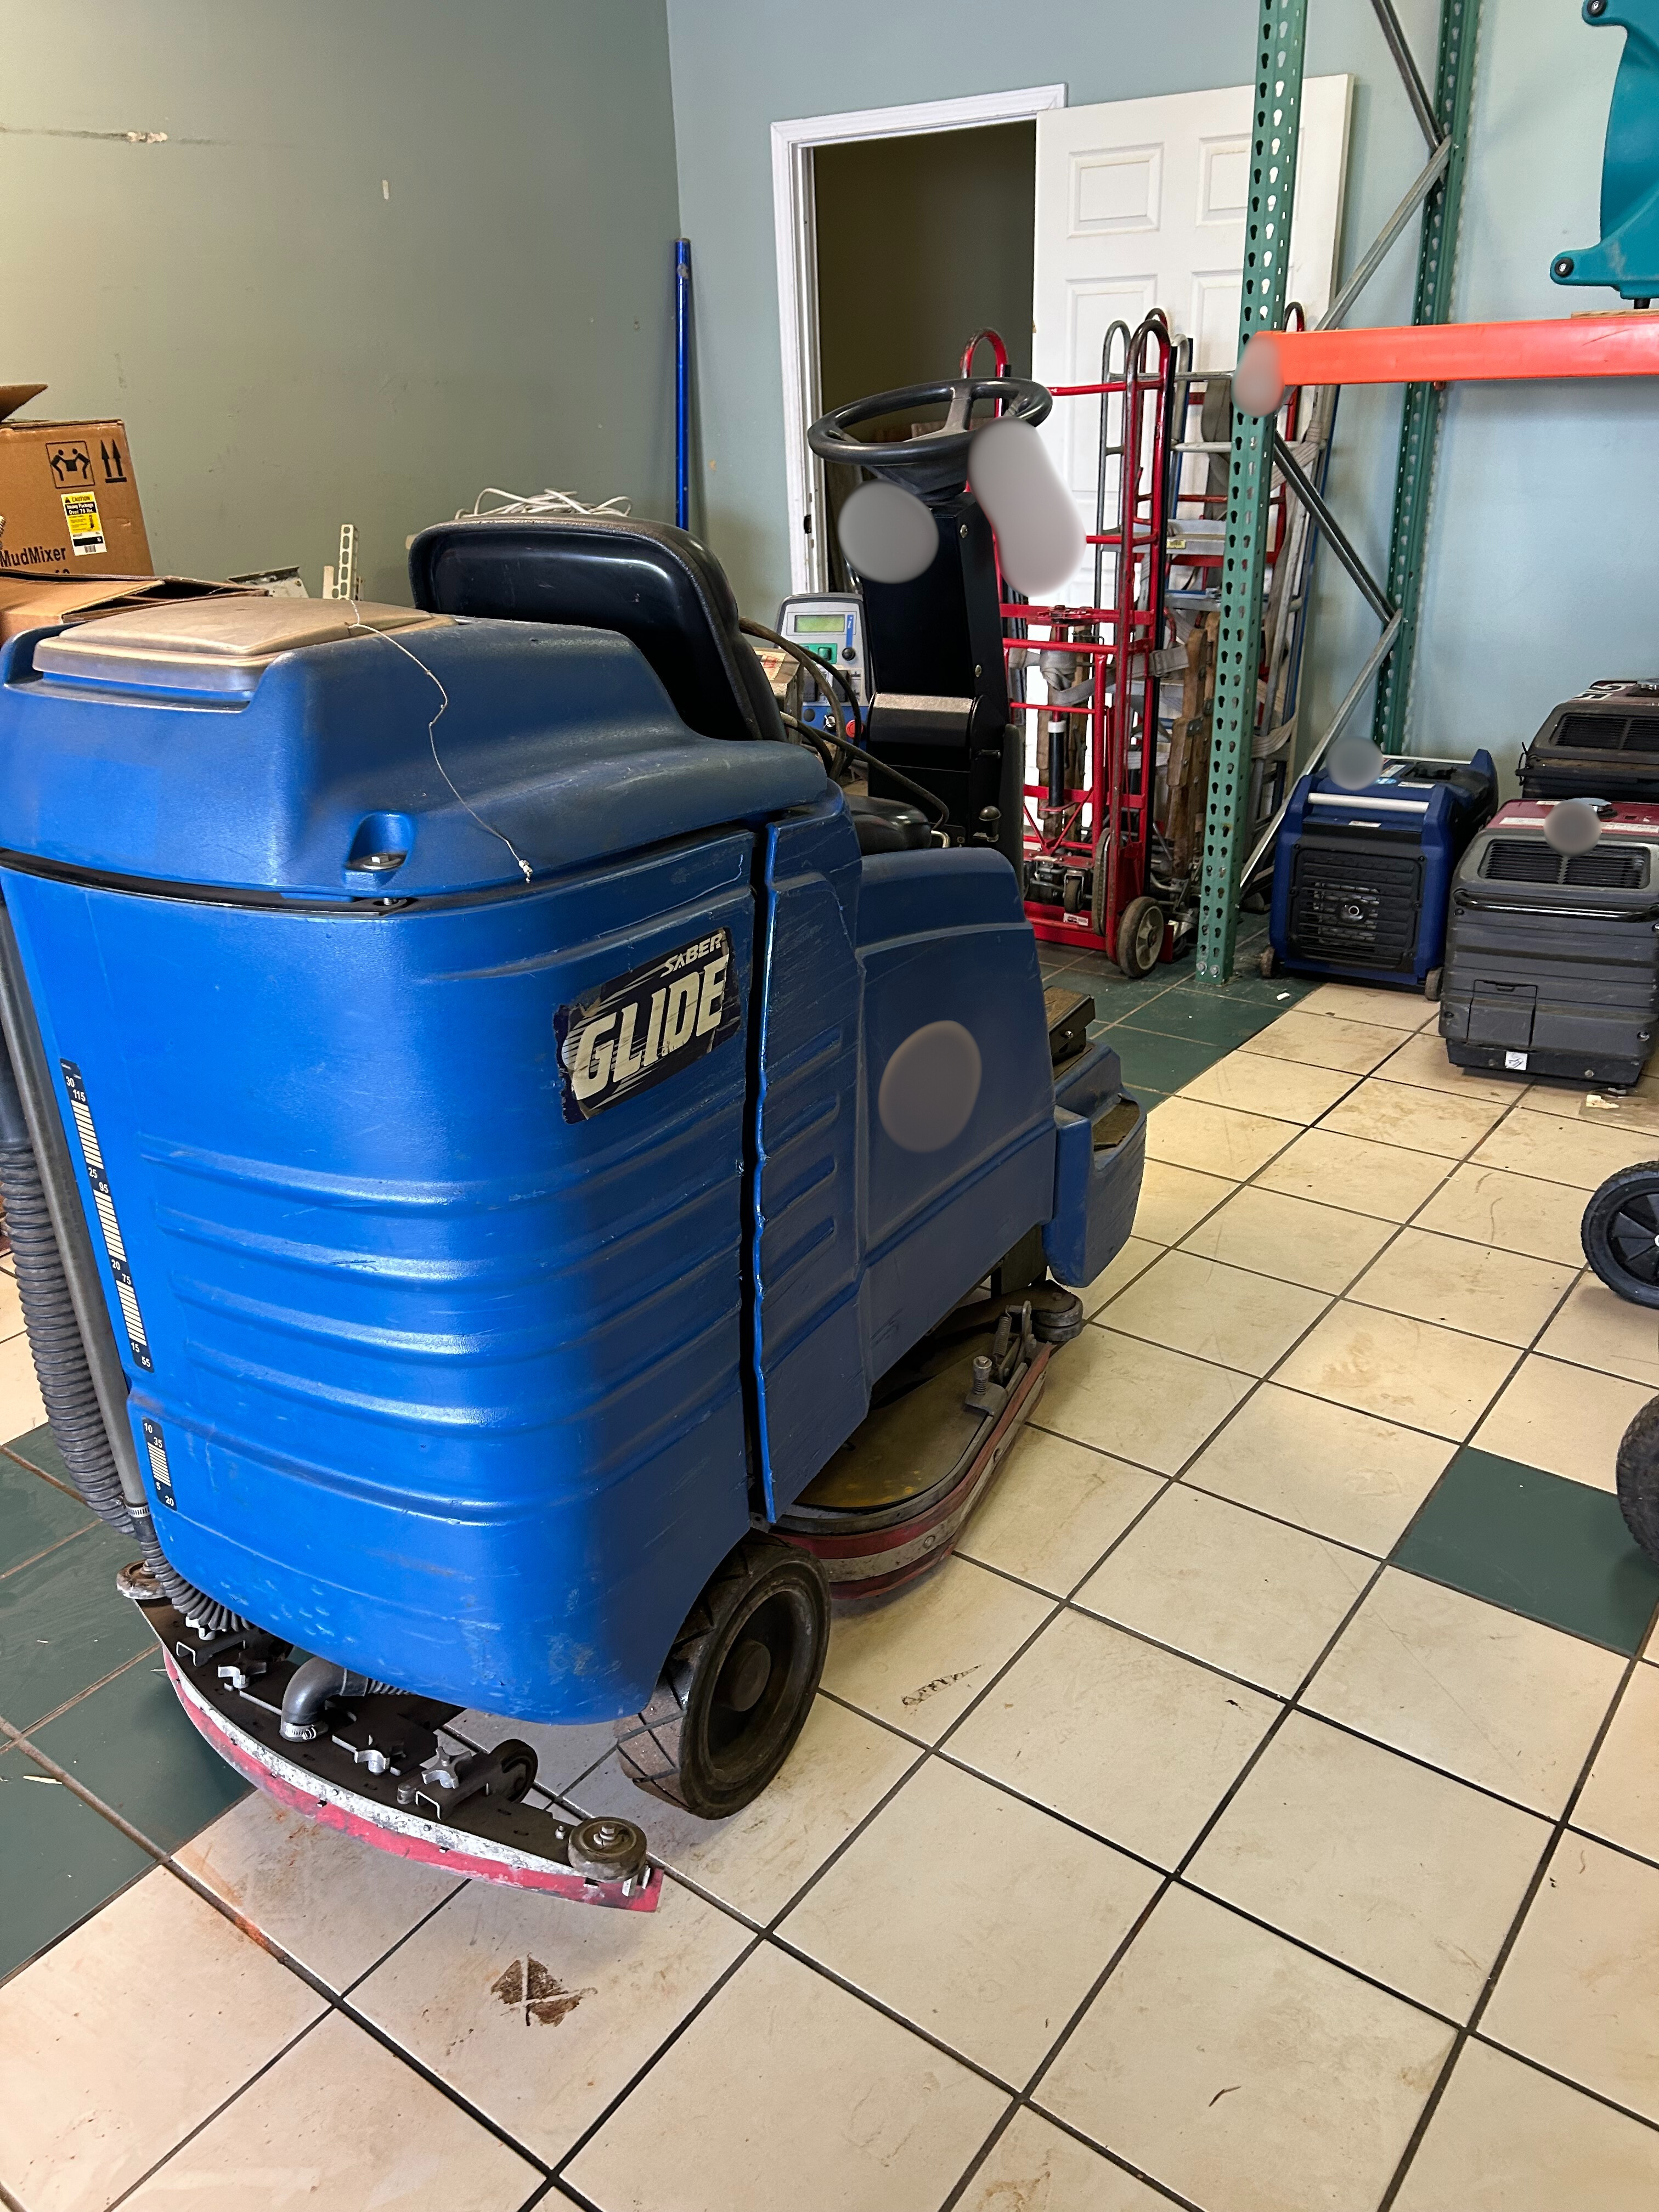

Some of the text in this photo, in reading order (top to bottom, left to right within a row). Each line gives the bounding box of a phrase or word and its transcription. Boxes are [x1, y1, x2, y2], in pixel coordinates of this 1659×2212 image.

[0, 546, 66, 567] MudMixer
[660, 933, 723, 978] SABER
[572, 953, 729, 1100] GLIDE
[66, 1076, 75, 1087] 30
[72, 1089, 86, 1102] 115
[88, 1167, 98, 1178] 25
[99, 1182, 109, 1194] 95
[111, 1259, 121, 1271] 20
[121, 1273, 132, 1285] 75
[131, 1342, 140, 1353] 15
[141, 1356, 151, 1368] 55
[144, 1423, 153, 1433] 10
[154, 1437, 162, 1448] 35
[156, 1481, 161, 1491] 5
[165, 1495, 174, 1506] 20
